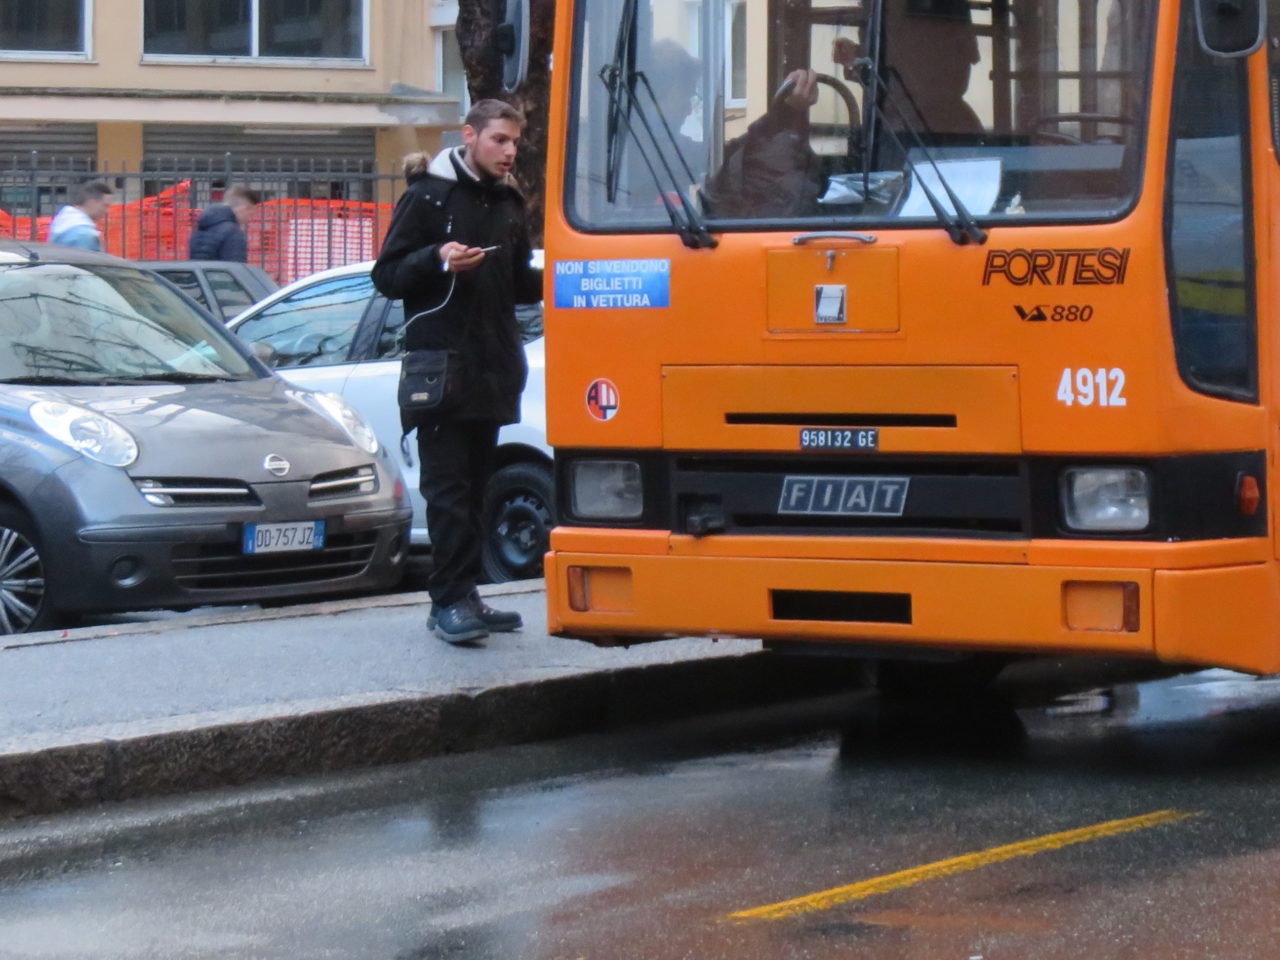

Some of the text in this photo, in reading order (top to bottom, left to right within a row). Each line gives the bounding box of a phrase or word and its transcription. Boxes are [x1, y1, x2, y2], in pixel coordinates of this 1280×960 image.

[556, 259, 669, 275] NON SI VENDONO
[981, 247, 1131, 287] PORTESI
[580, 277, 643, 292] BIGLIETTI
[573, 292, 651, 308] IN VETTURA
[1057, 367, 1127, 407] 4912
[801, 430, 876, 447] 958132 GE
[787, 481, 902, 510] FIAT
